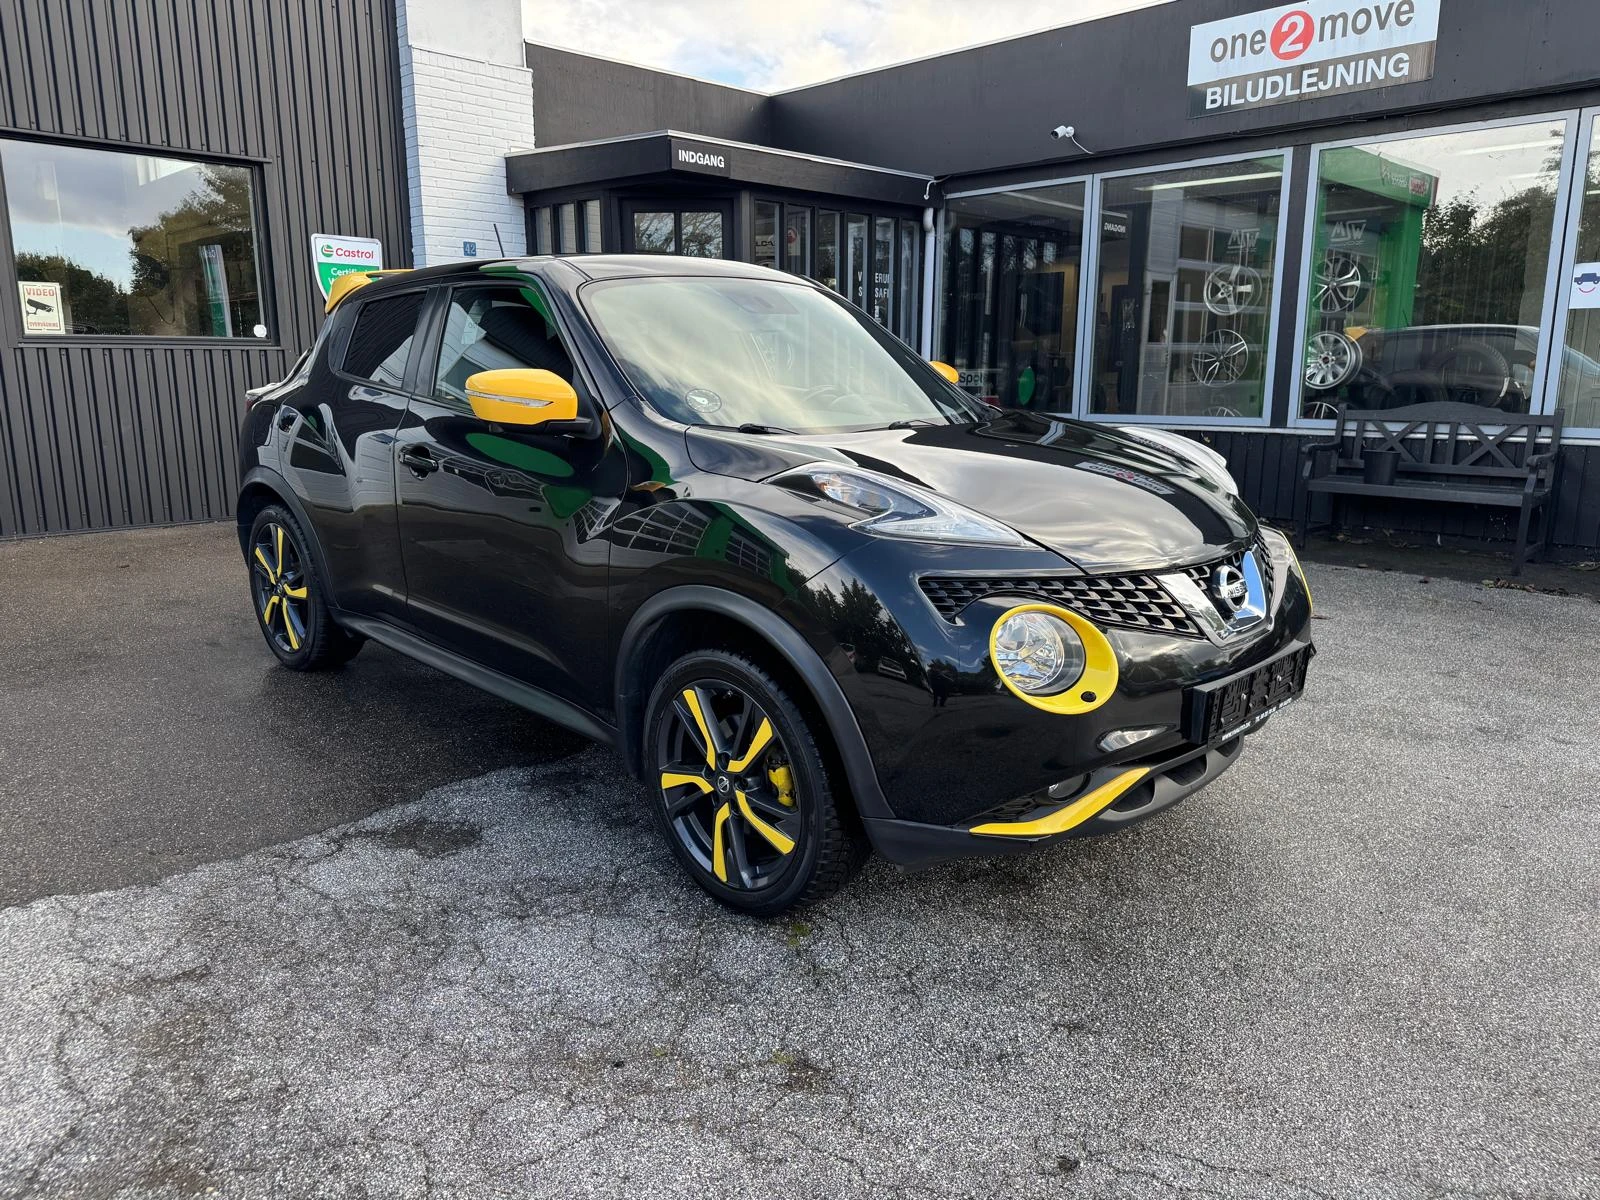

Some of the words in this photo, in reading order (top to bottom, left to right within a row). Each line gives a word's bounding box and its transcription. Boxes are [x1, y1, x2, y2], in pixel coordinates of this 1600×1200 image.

[1205, 52, 1410, 110] BILUDLEJNING
[678, 149, 725, 168] INDGANG
[335, 247, 374, 259] Castrol
[464, 242, 476, 255] 42
[26, 287, 55, 296] VIDEO
